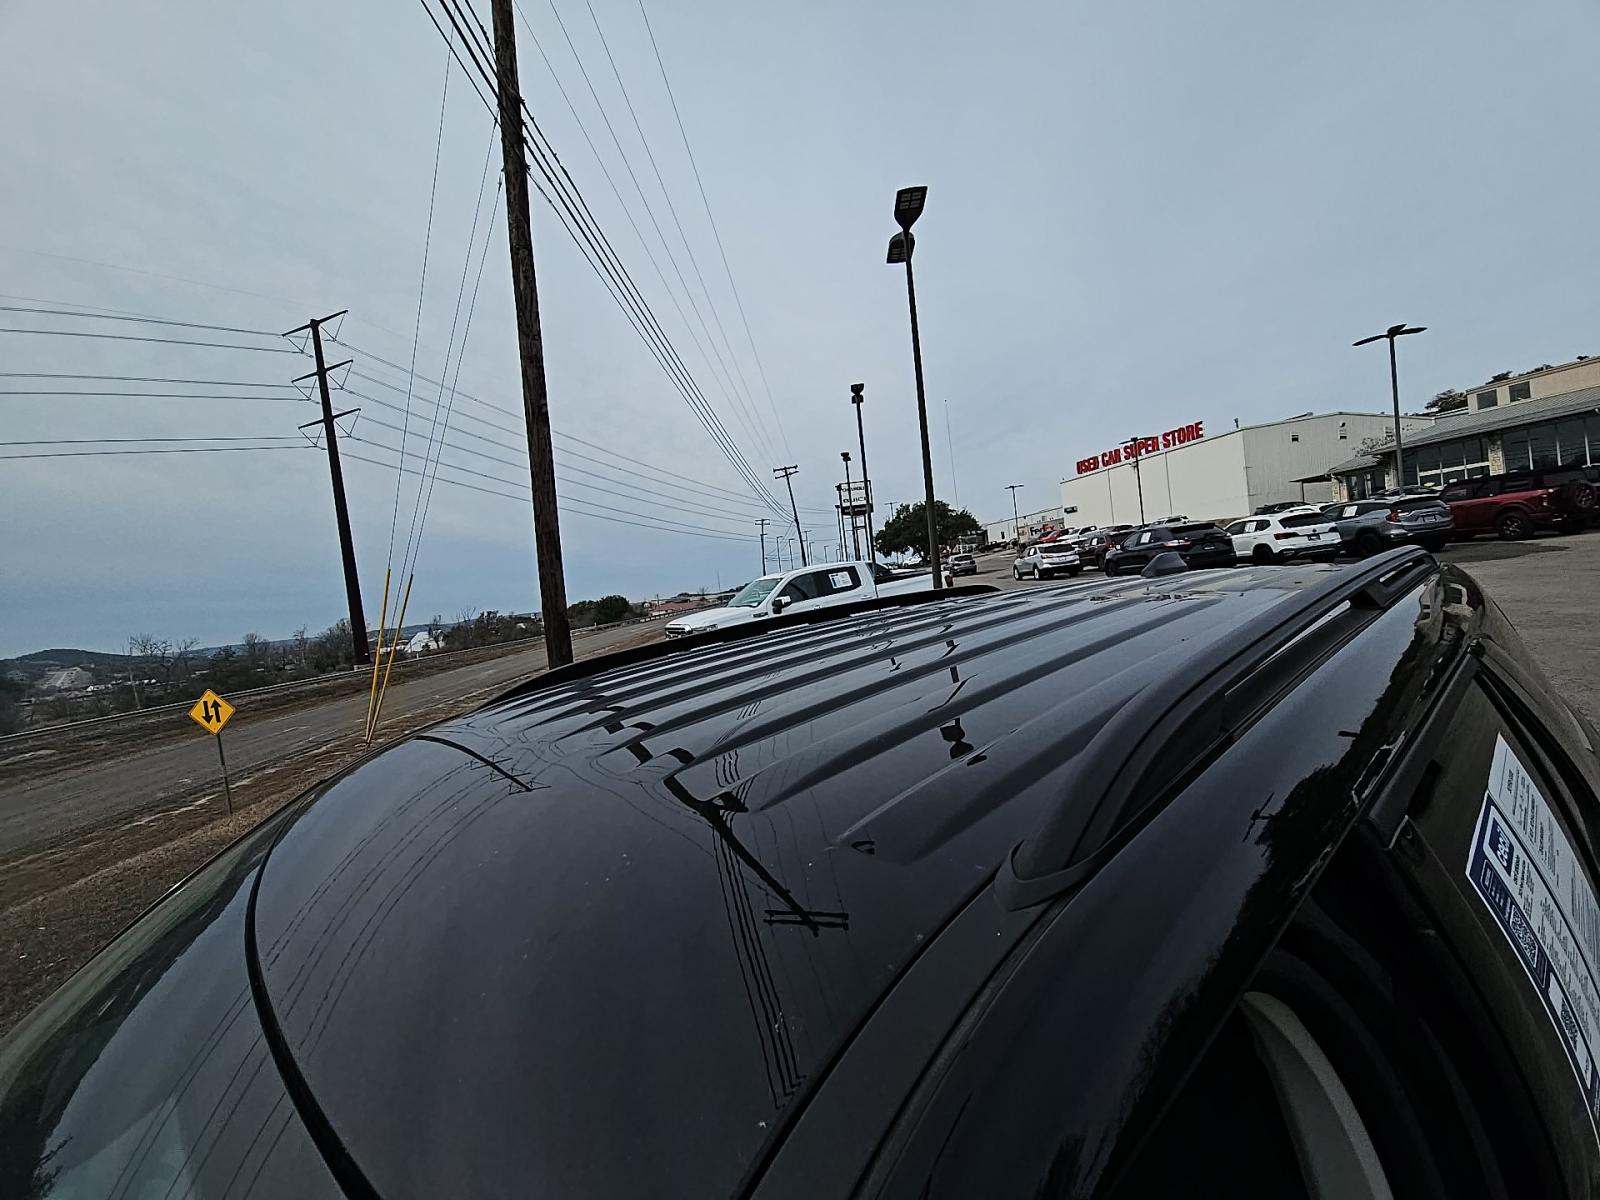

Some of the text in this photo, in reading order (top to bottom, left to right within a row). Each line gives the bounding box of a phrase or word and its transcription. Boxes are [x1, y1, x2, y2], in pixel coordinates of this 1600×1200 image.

[1076, 421, 1204, 474] USED CAR SUPER STORE
